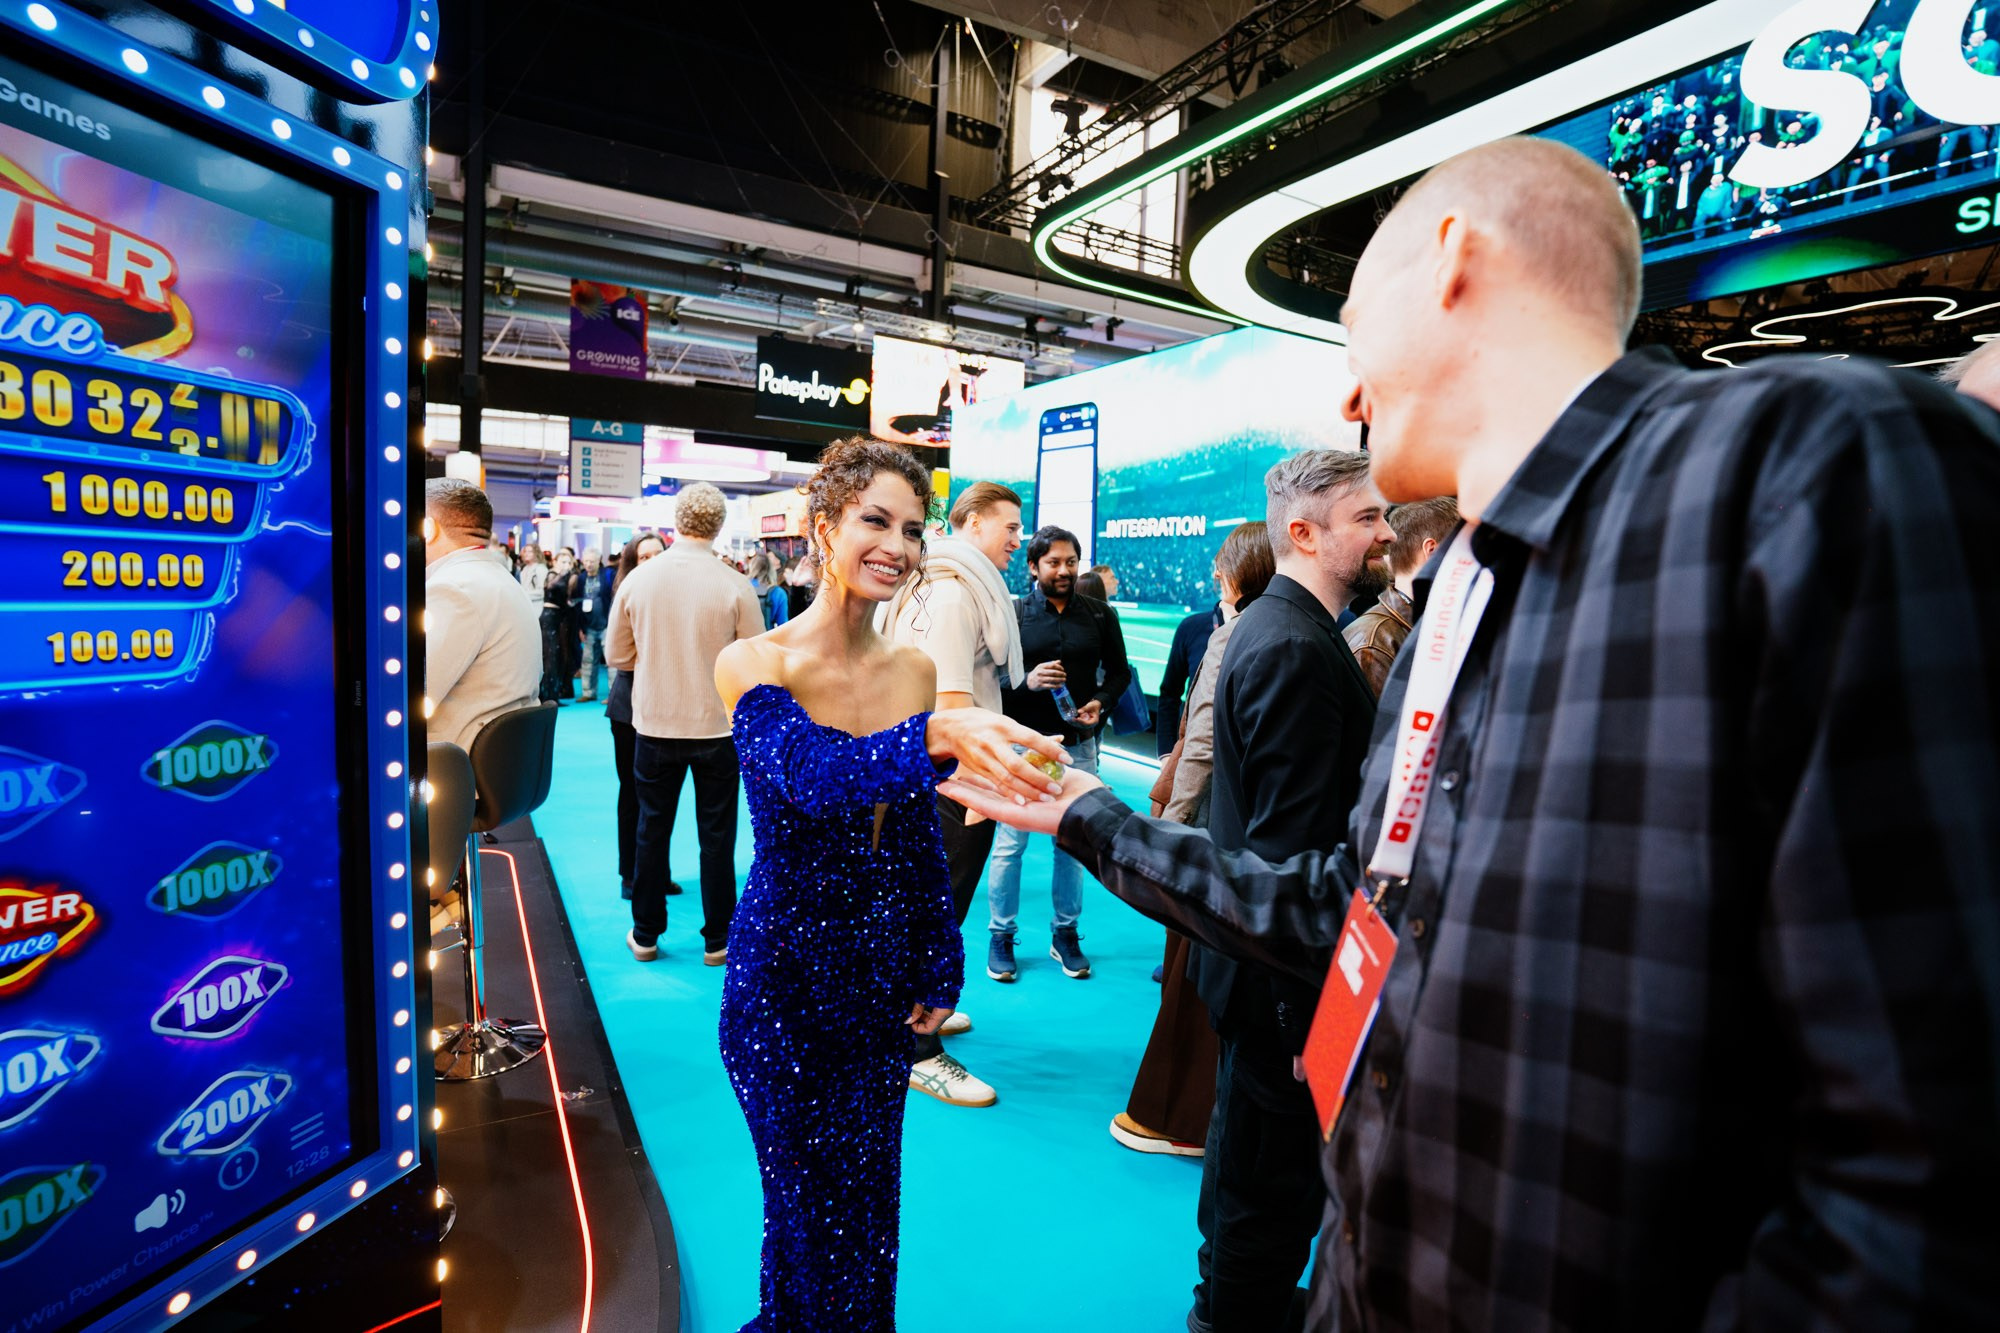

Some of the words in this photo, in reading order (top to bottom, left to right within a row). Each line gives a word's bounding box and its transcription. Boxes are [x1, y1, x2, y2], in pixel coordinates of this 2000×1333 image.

[0, 77, 111, 140] Games
[616, 308, 641, 321] ICE
[758, 363, 842, 408] Pateplay
[591, 420, 624, 436] A-G
[1106, 515, 1206, 539] INTEGRATION
[62, 550, 204, 587] 200.00
[47, 628, 174, 663] 100.00
[155, 734, 270, 788] 1000X
[160, 850, 275, 912] 1000X
[178, 963, 267, 1028] 100X
[180, 1076, 277, 1149] 200X
[286, 1145, 330, 1179] 12:28
[22, 1297, 65, 1331] Win
[69, 1261, 130, 1306] Power
